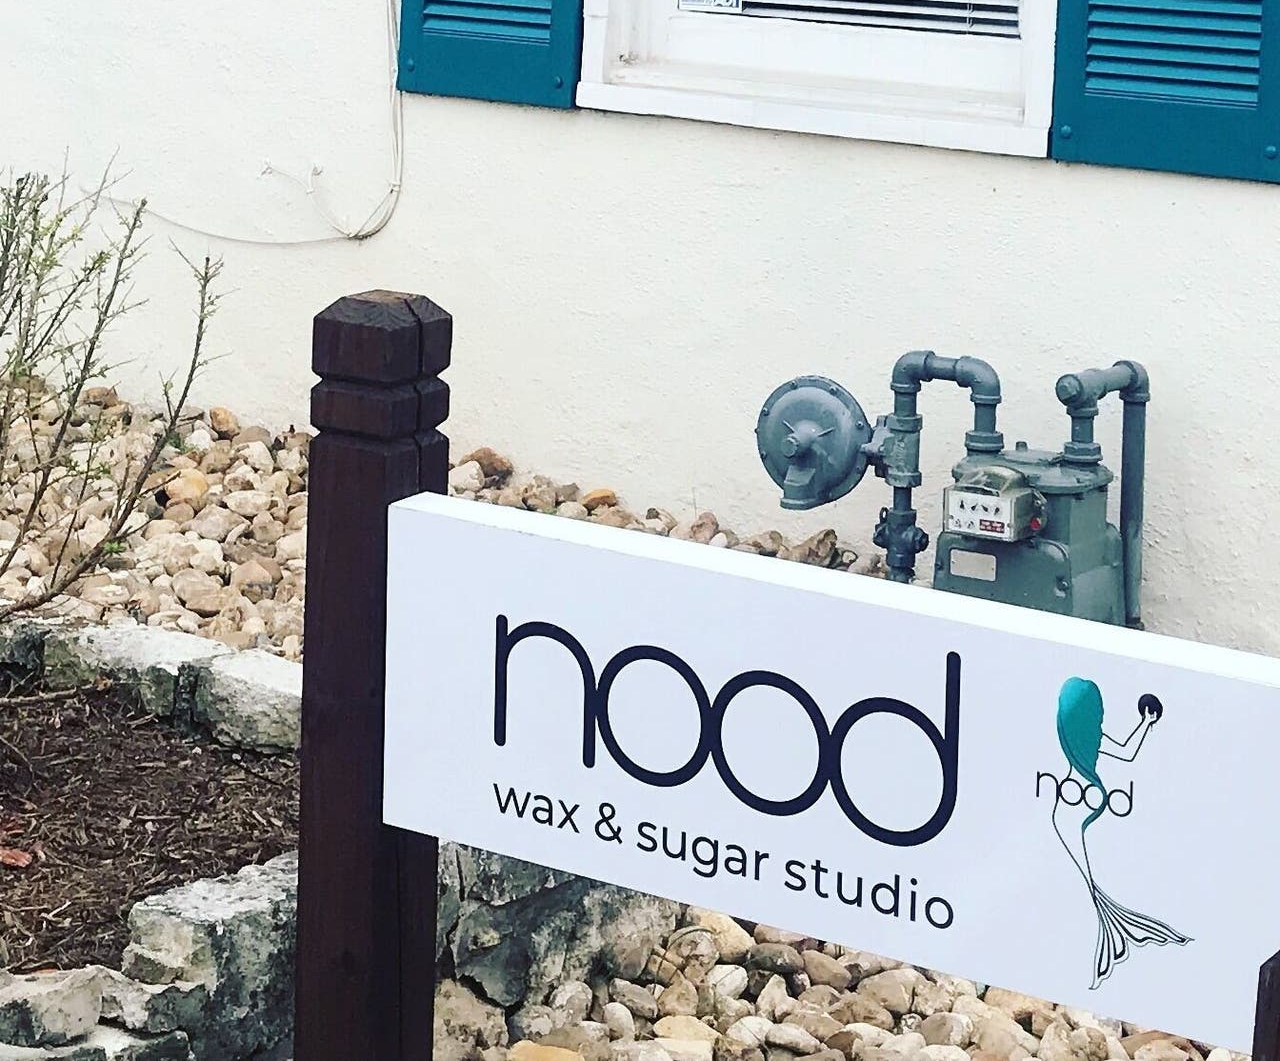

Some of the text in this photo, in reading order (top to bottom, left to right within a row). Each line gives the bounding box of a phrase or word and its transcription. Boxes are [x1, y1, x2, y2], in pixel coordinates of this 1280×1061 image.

[494, 615, 961, 846] nood
[1036, 771, 1134, 817] nood
[493, 784, 954, 930] wax & sugar studio
